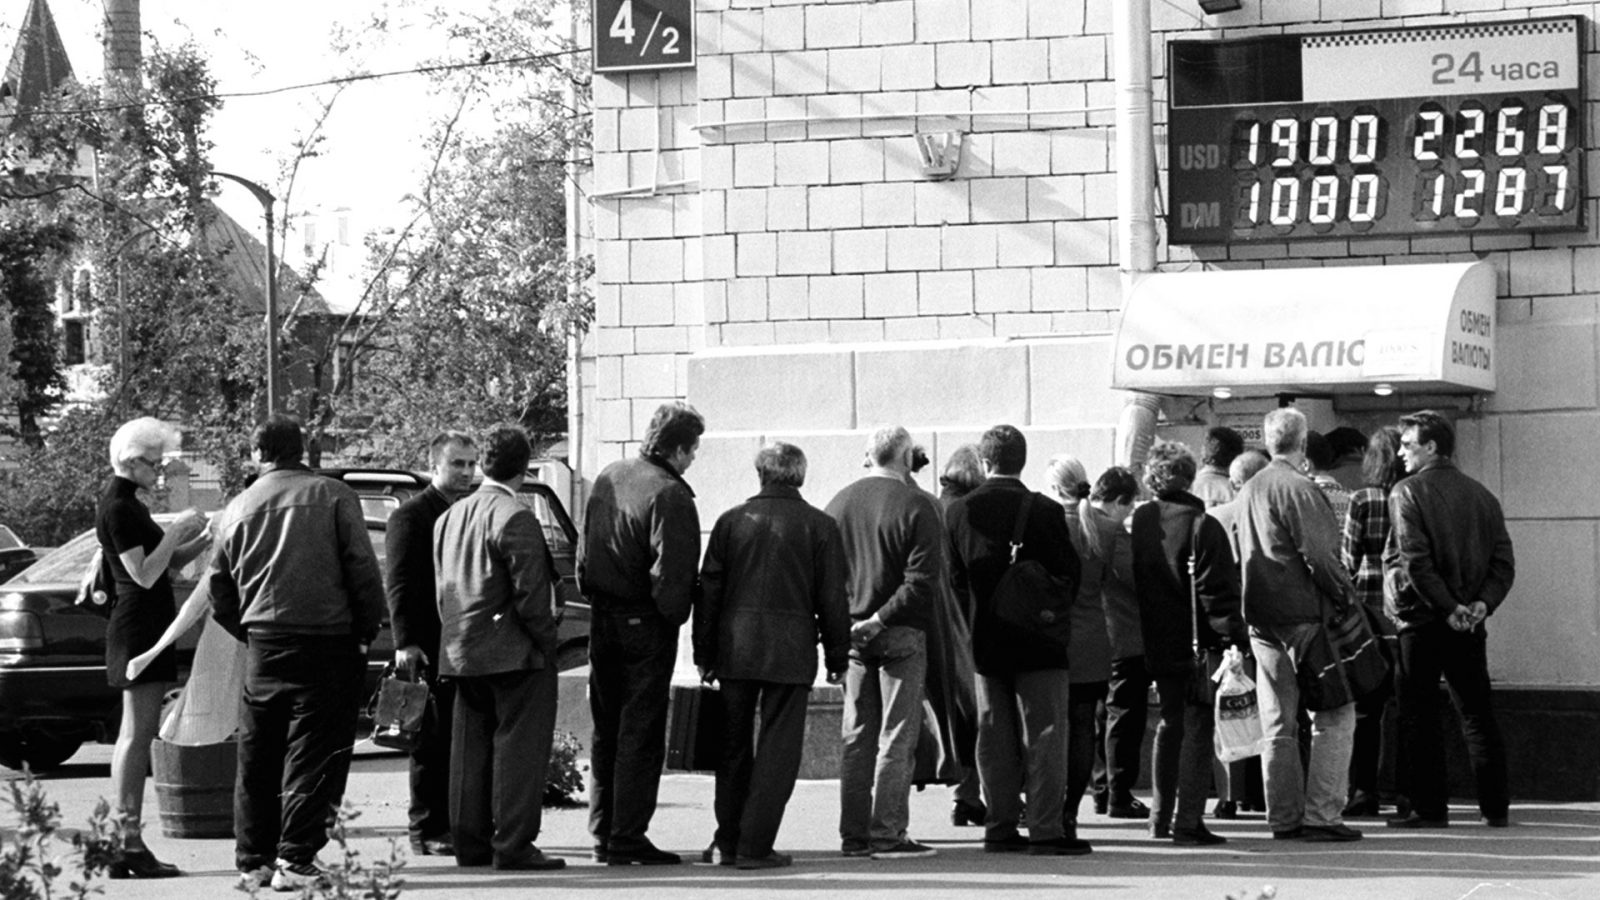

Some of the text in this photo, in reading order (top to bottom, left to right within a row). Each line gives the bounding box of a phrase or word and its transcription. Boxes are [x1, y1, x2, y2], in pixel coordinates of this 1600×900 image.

[1431, 51, 1560, 85] 24 часа
[1179, 104, 1569, 171] USD 1900 2268
[1180, 165, 1569, 229] DM 1080 1287
[1460, 309, 1491, 338] ОБМЕН
[1125, 339, 1365, 371] ОБМЕН ВАЛЮ
[1451, 340, 1491, 371] ВАЛЮТЫ
